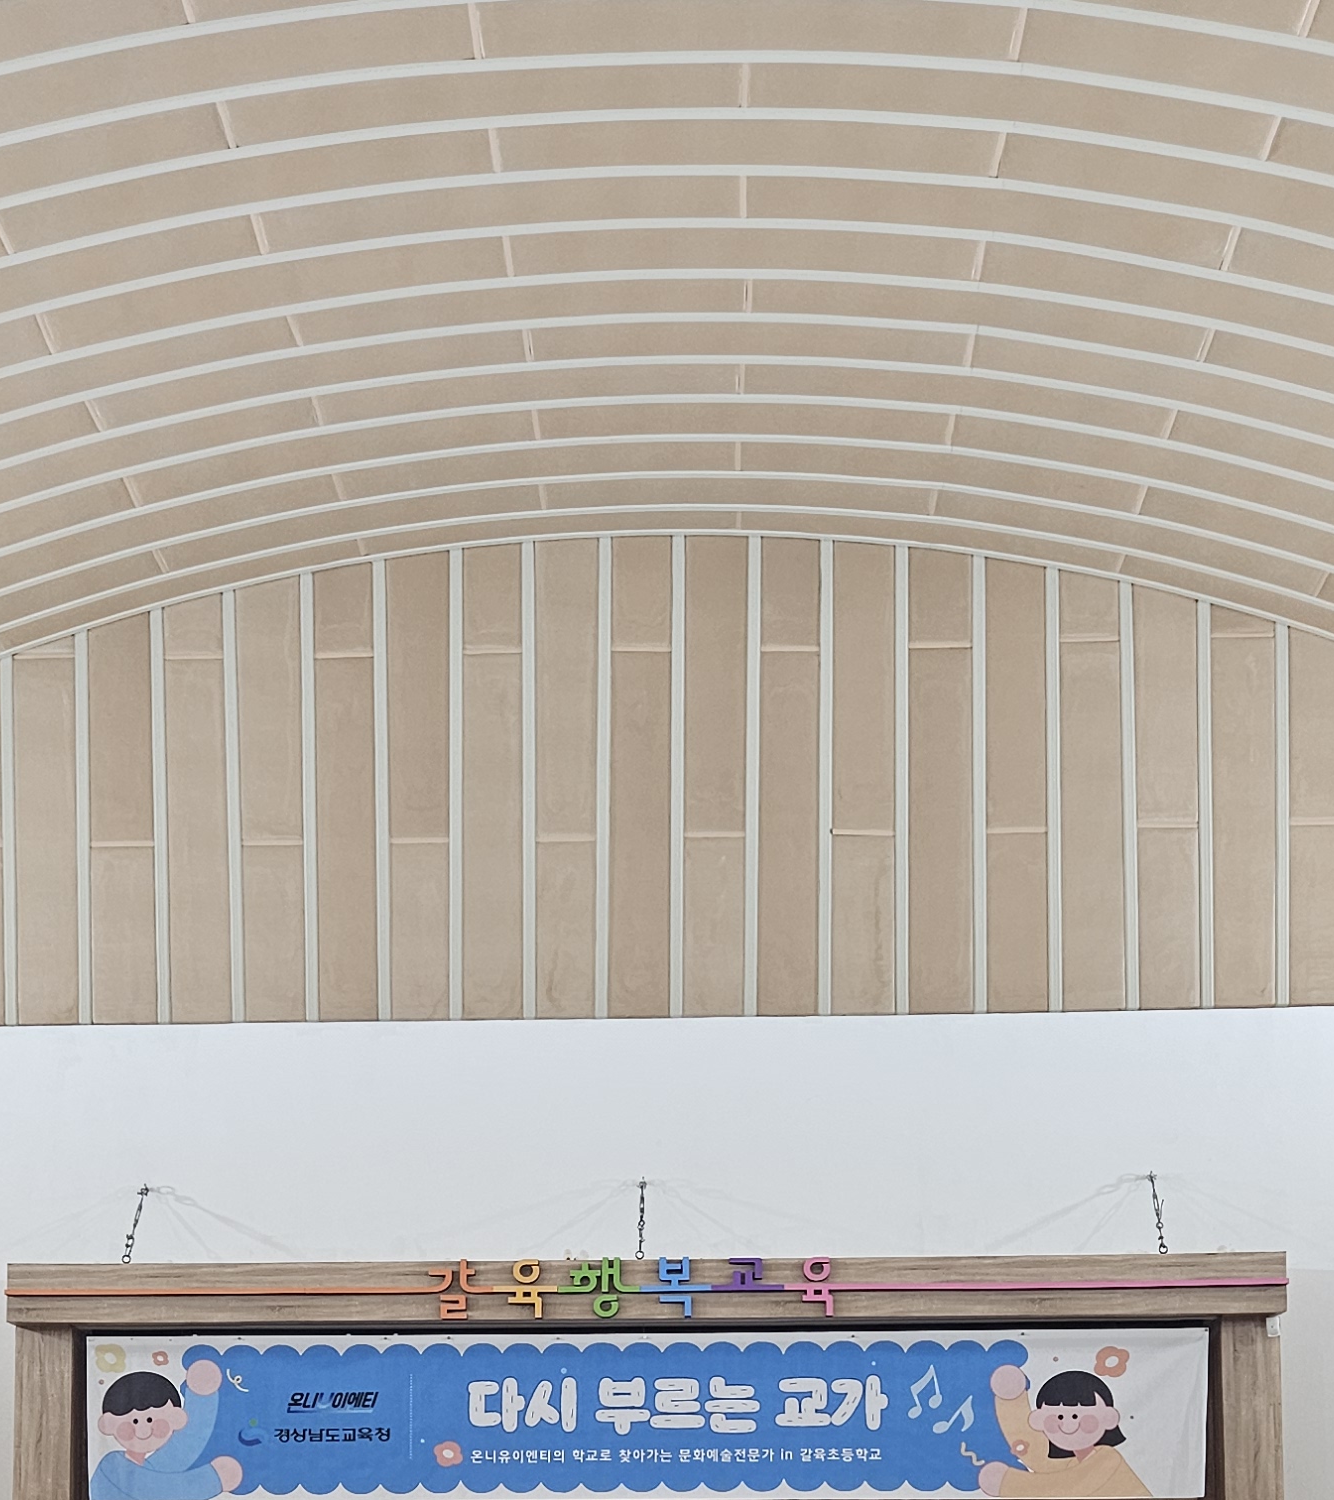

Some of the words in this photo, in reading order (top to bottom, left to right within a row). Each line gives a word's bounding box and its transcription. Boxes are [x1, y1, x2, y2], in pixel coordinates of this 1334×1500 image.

[466, 1376, 578, 1434] 다시
[594, 1376, 761, 1436] 부르는
[773, 1374, 889, 1432] 교가
[273, 1426, 391, 1444] 경상남도교육청
[470, 1448, 565, 1464] 온니유이엔티의
[572, 1448, 612, 1464] 학교로
[618, 1448, 673, 1464] 찾아가는
[678, 1447, 775, 1463] 문화예술전문가
[780, 1447, 793, 1461] in
[799, 1447, 883, 1462] 갈육초등학교
